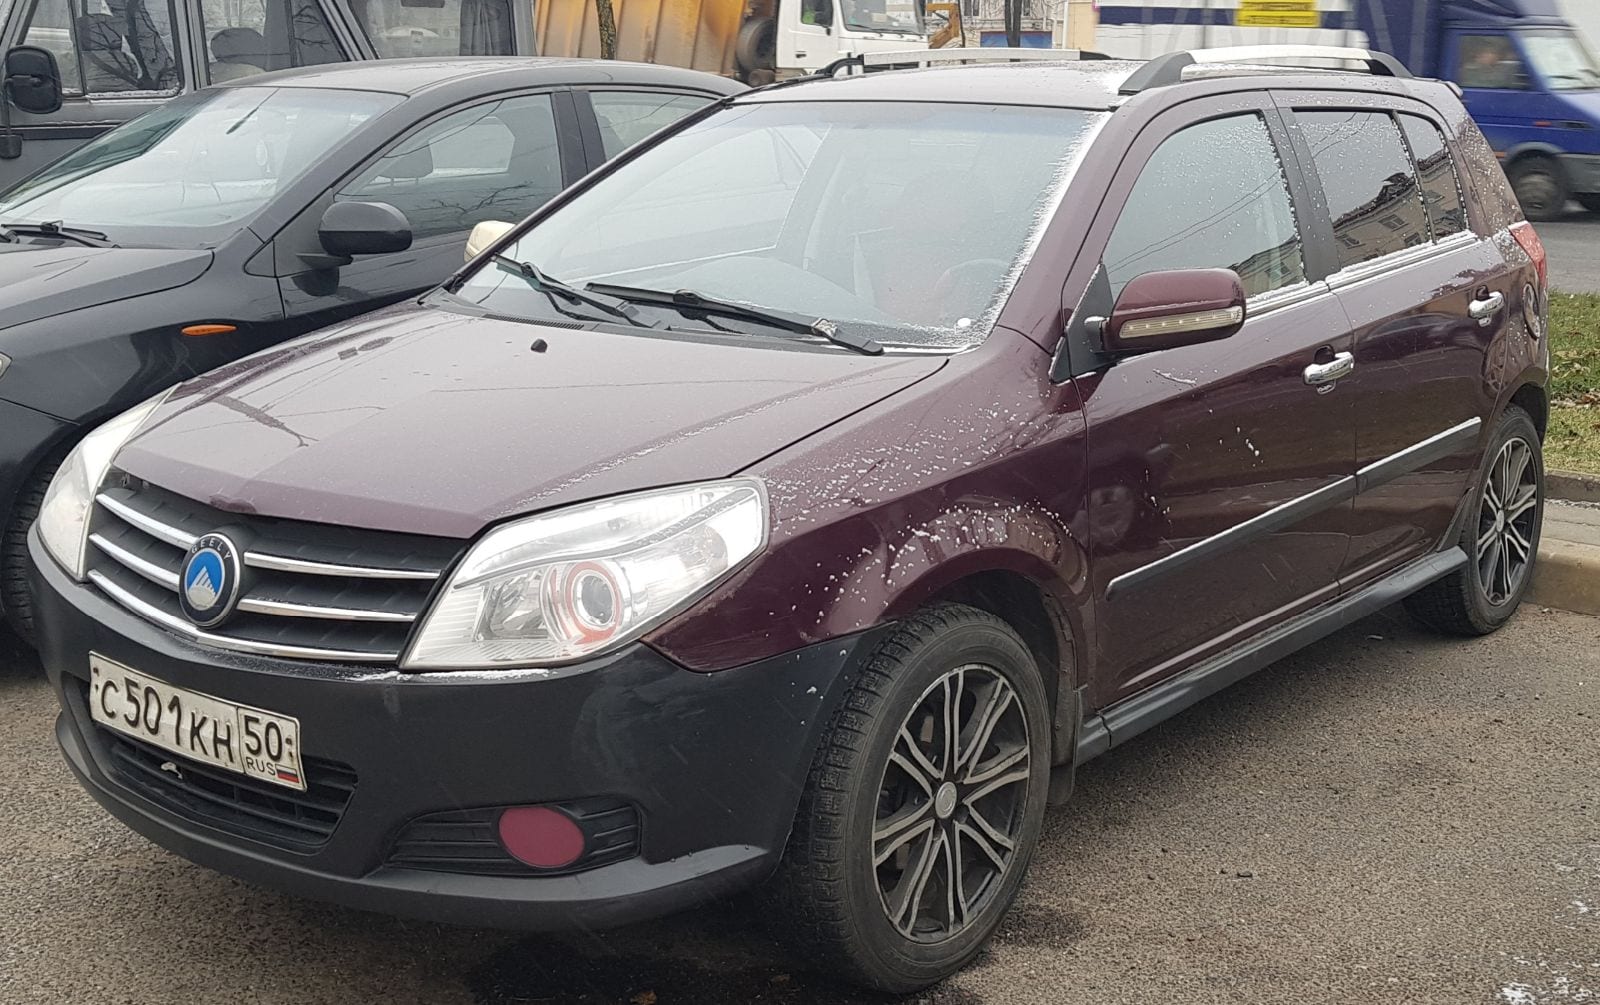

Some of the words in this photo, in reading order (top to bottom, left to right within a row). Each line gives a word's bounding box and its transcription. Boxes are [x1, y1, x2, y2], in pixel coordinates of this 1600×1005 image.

[191, 538, 231, 559] GEELY
[243, 715, 282, 761] 50
[247, 757, 276, 776] RUS
